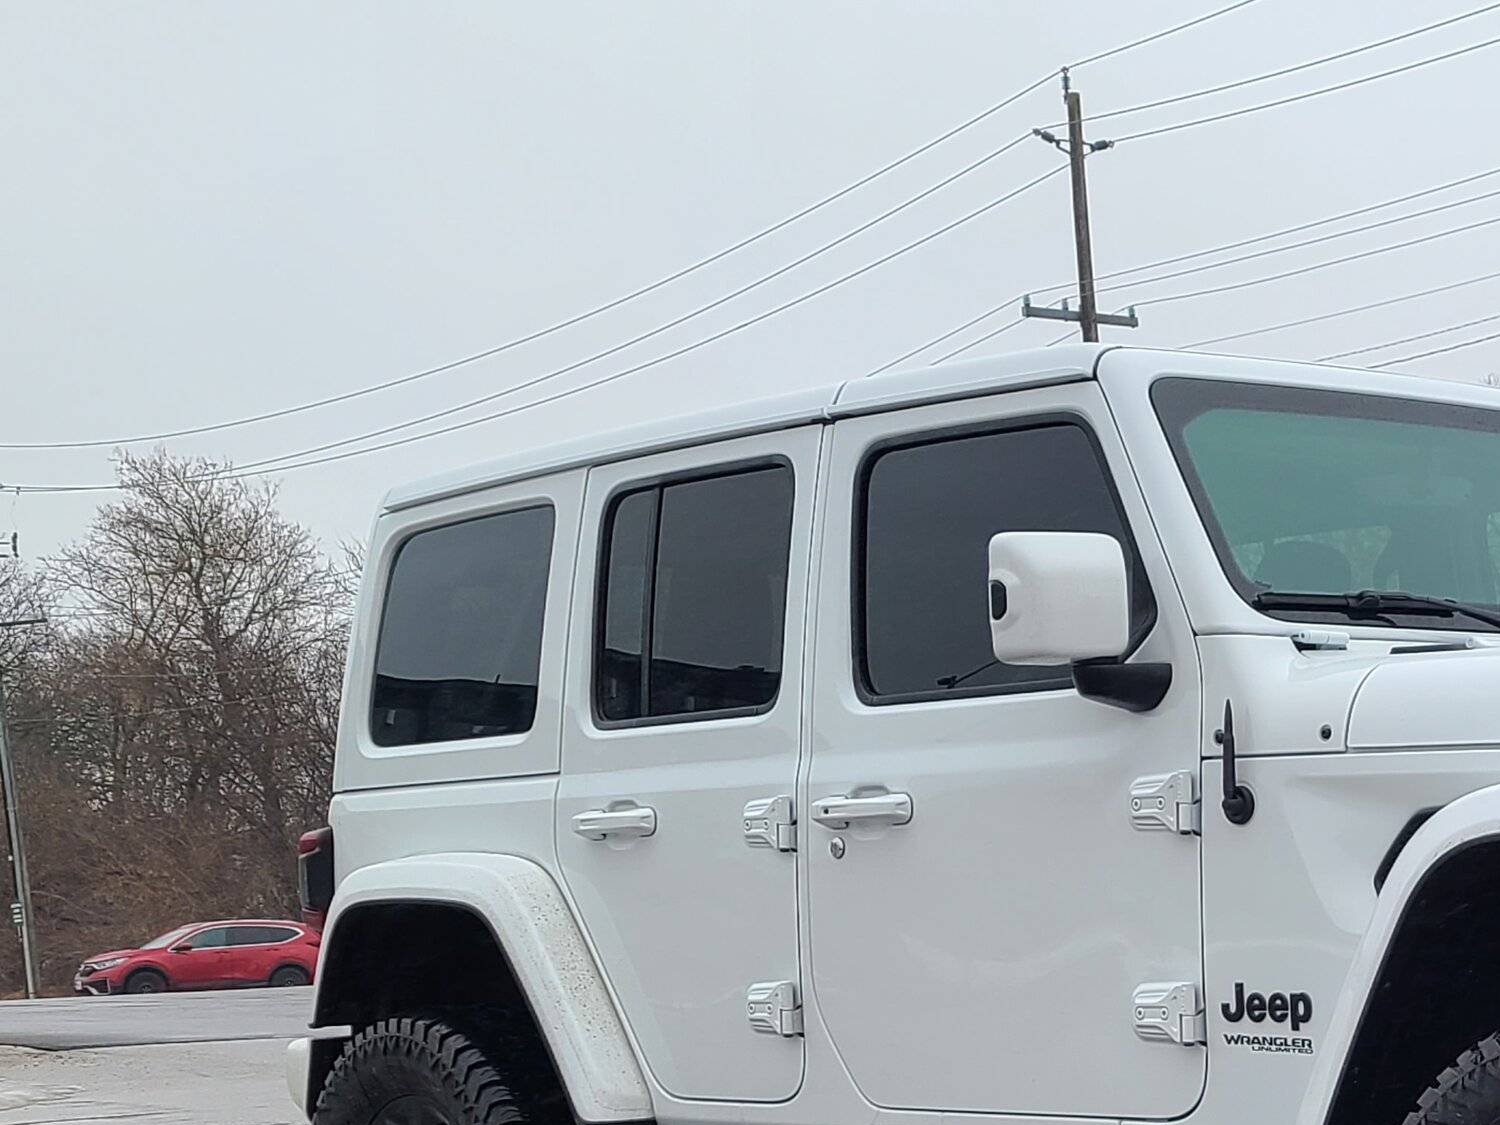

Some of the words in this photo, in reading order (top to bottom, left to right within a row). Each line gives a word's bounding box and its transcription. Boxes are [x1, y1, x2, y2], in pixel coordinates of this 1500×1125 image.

[1221, 982, 1313, 1032] Jeep
[1223, 1034, 1313, 1049] WRANGLER
[1251, 1046, 1314, 1055] UNLIMITED
